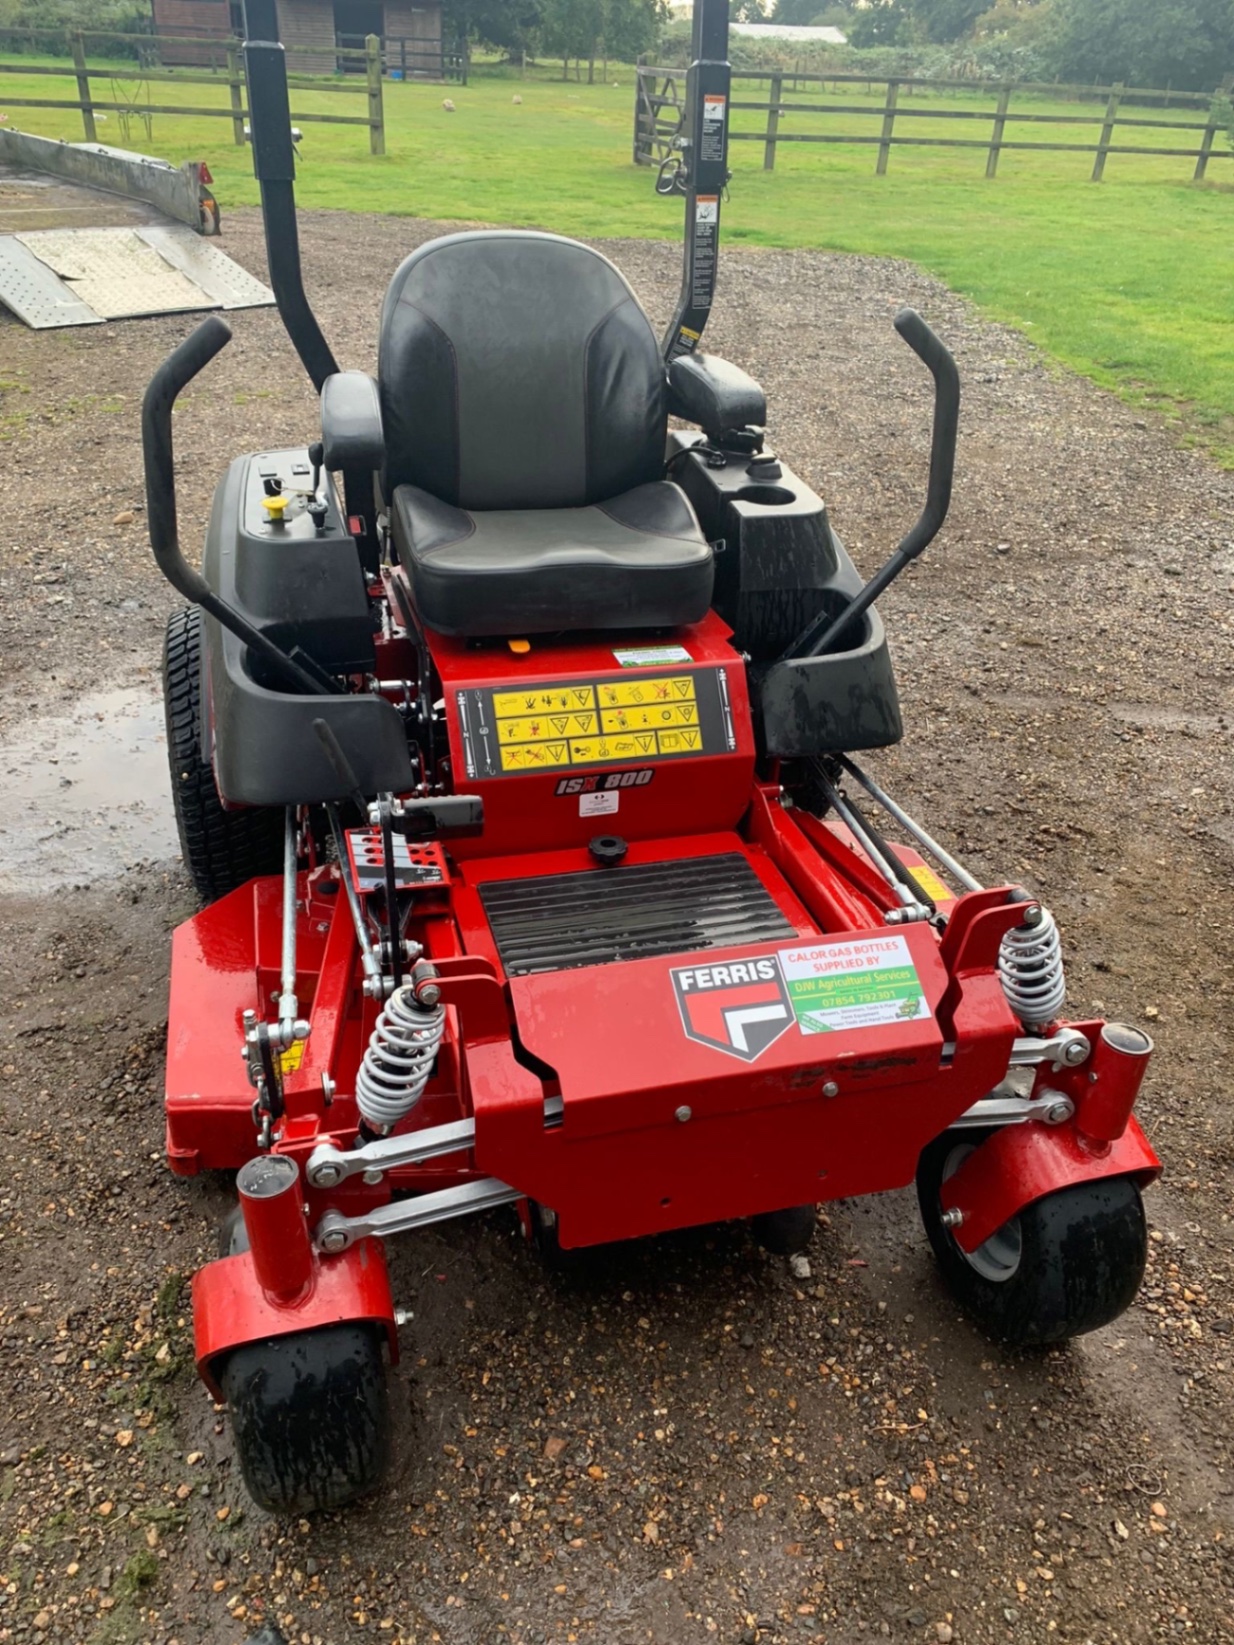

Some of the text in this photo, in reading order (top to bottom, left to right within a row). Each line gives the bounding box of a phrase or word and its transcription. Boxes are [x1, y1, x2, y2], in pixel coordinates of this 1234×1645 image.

[556, 769, 654, 795] ISX 800
[788, 941, 899, 963] CALOR GAS BOTTLES
[678, 960, 775, 991] FERRIS
[813, 956, 880, 973] SUPPLIED BY
[794, 981, 816, 993] DJW
[818, 973, 872, 991] Agricultural
[874, 969, 911, 983] Services
[822, 990, 896, 1008] 07854 792301
